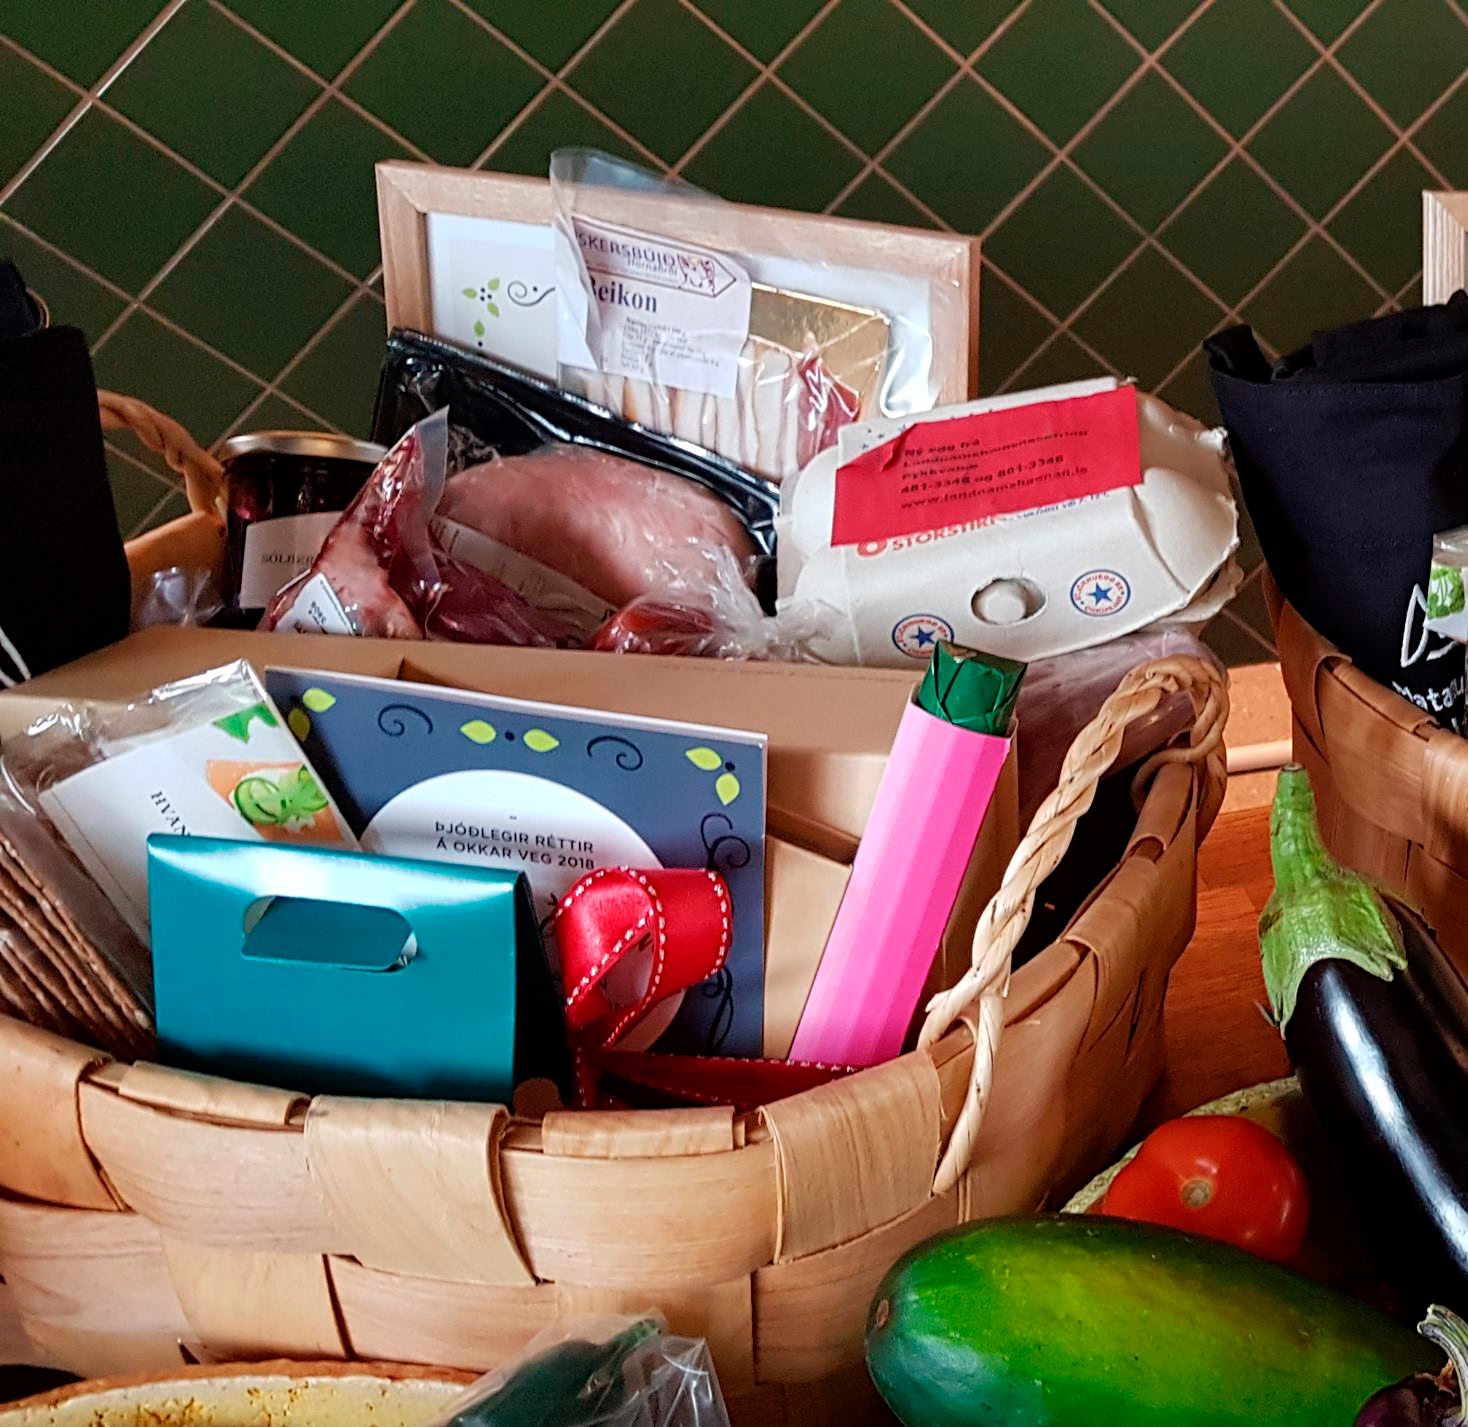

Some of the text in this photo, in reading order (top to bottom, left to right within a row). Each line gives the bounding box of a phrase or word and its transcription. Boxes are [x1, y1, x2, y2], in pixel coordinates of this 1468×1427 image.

[434, 819, 595, 854] ÞJÓÐLEGIR RÉTTIR
[436, 836, 596, 871] Á OKKAR VEG 2018
